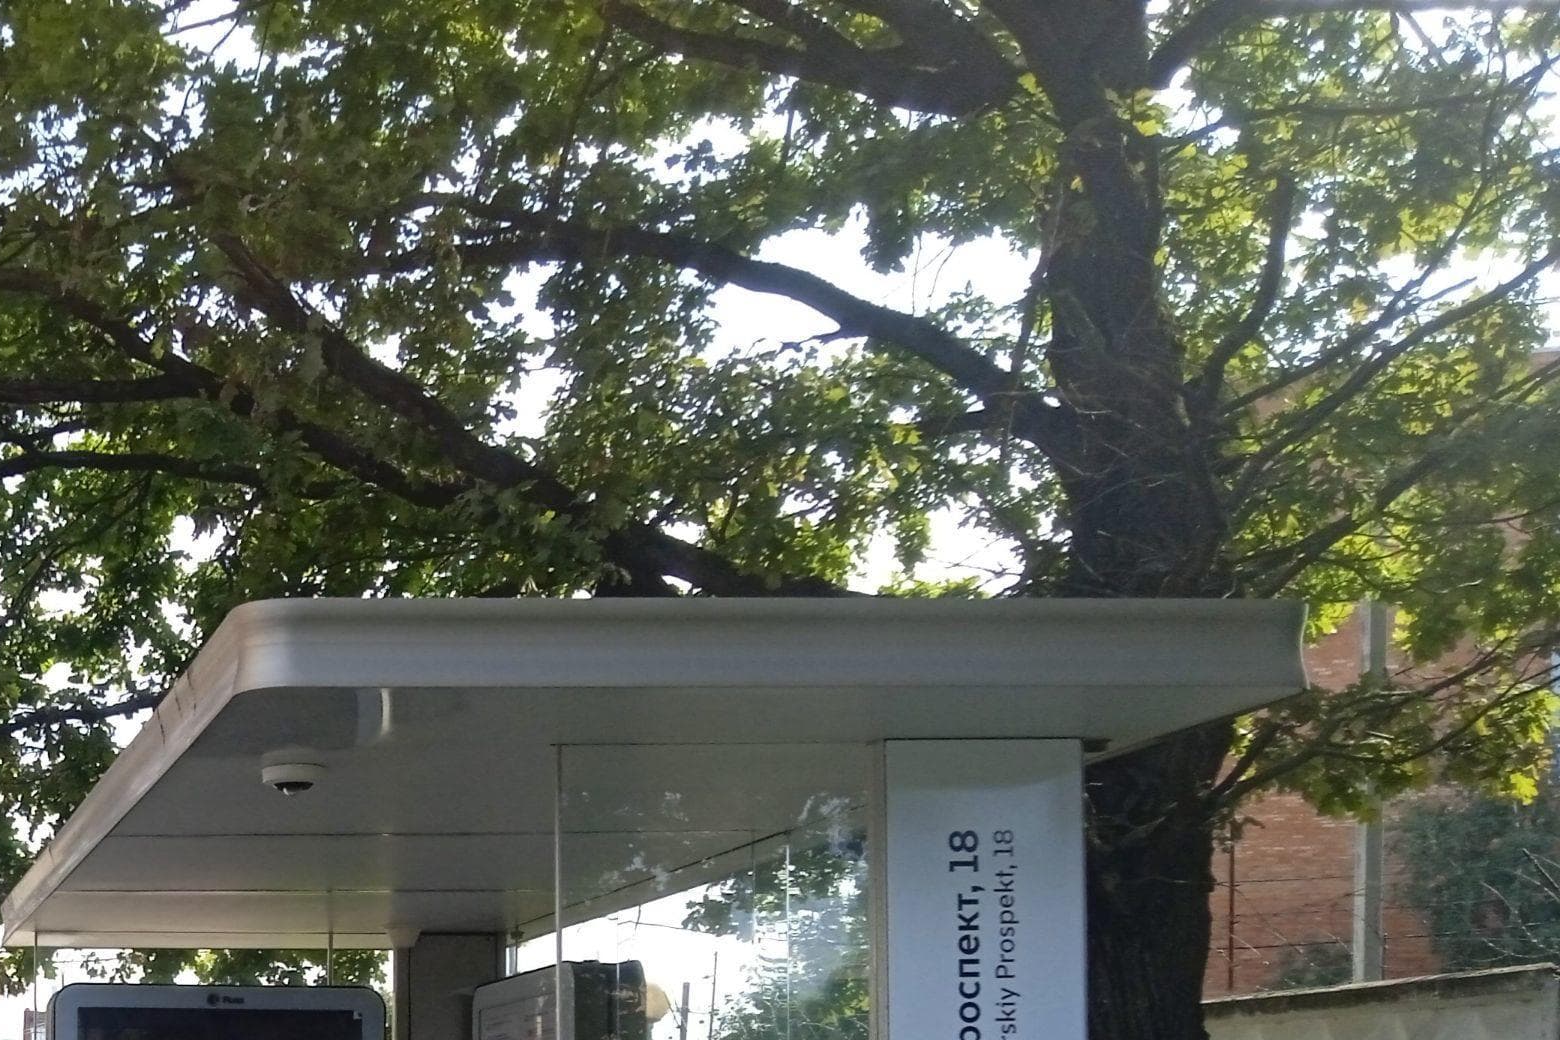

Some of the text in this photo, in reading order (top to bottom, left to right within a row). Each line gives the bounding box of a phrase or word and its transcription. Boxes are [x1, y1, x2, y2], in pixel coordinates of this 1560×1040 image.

[948, 830, 980, 872] 18
[992, 829, 1015, 857] 18
[993, 864, 1020, 979] Prospekt,
